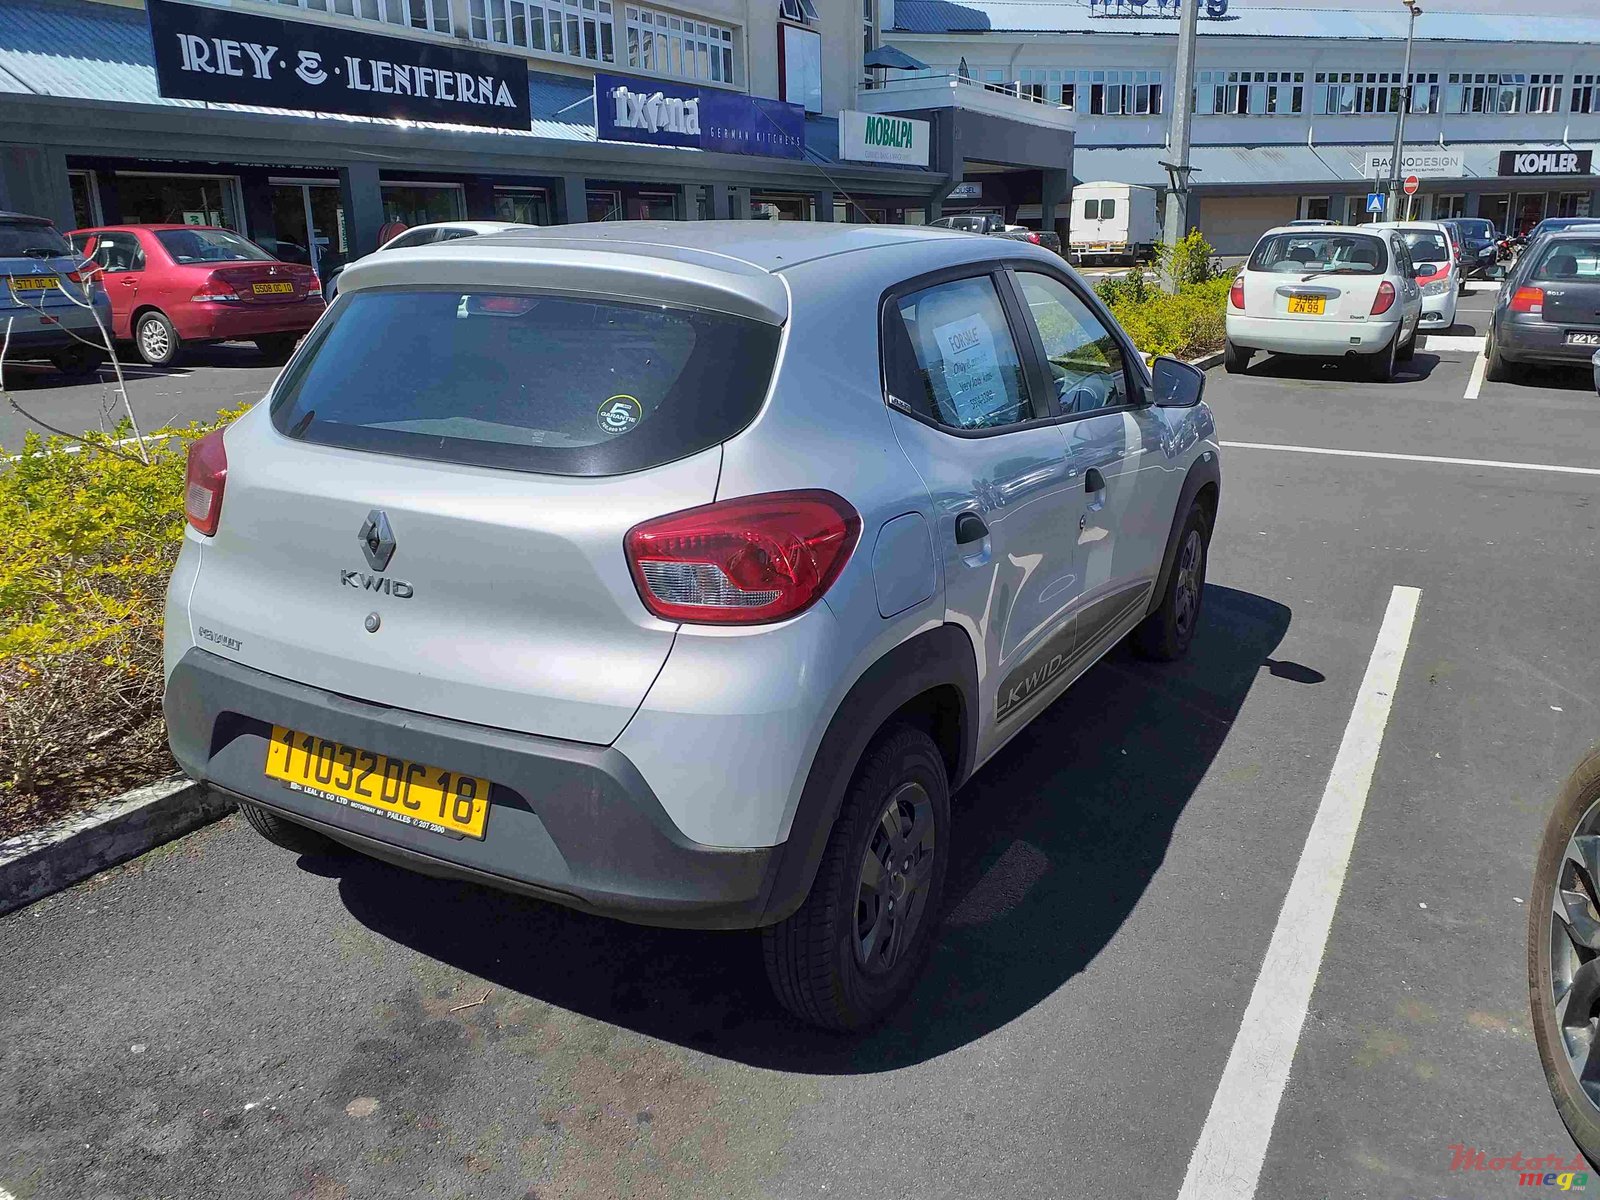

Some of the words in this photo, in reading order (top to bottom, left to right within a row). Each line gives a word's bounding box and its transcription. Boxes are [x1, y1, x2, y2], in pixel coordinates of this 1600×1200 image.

[176, 33, 279, 80] REY
[344, 56, 517, 108] LENFERNA
[709, 126, 749, 141] GERMAN
[756, 133, 801, 147] KITCHENS
[864, 116, 913, 149] MOBALPA
[1513, 153, 1578, 173] KOHLER
[1294, 303, 1305, 312] ZN
[1307, 304, 1319, 313] 99
[1572, 333, 1599, 344] 2212
[340, 568, 414, 599] KWID
[1007, 654, 1062, 708] KWID
[282, 730, 379, 798] 11032
[380, 759, 427, 810] DC
[437, 772, 478, 824] 18
[303, 786, 318, 797] LEAL
[326, 793, 335, 801] CO
[336, 796, 348, 805] LTD
[386, 811, 411, 824] PAILLES
